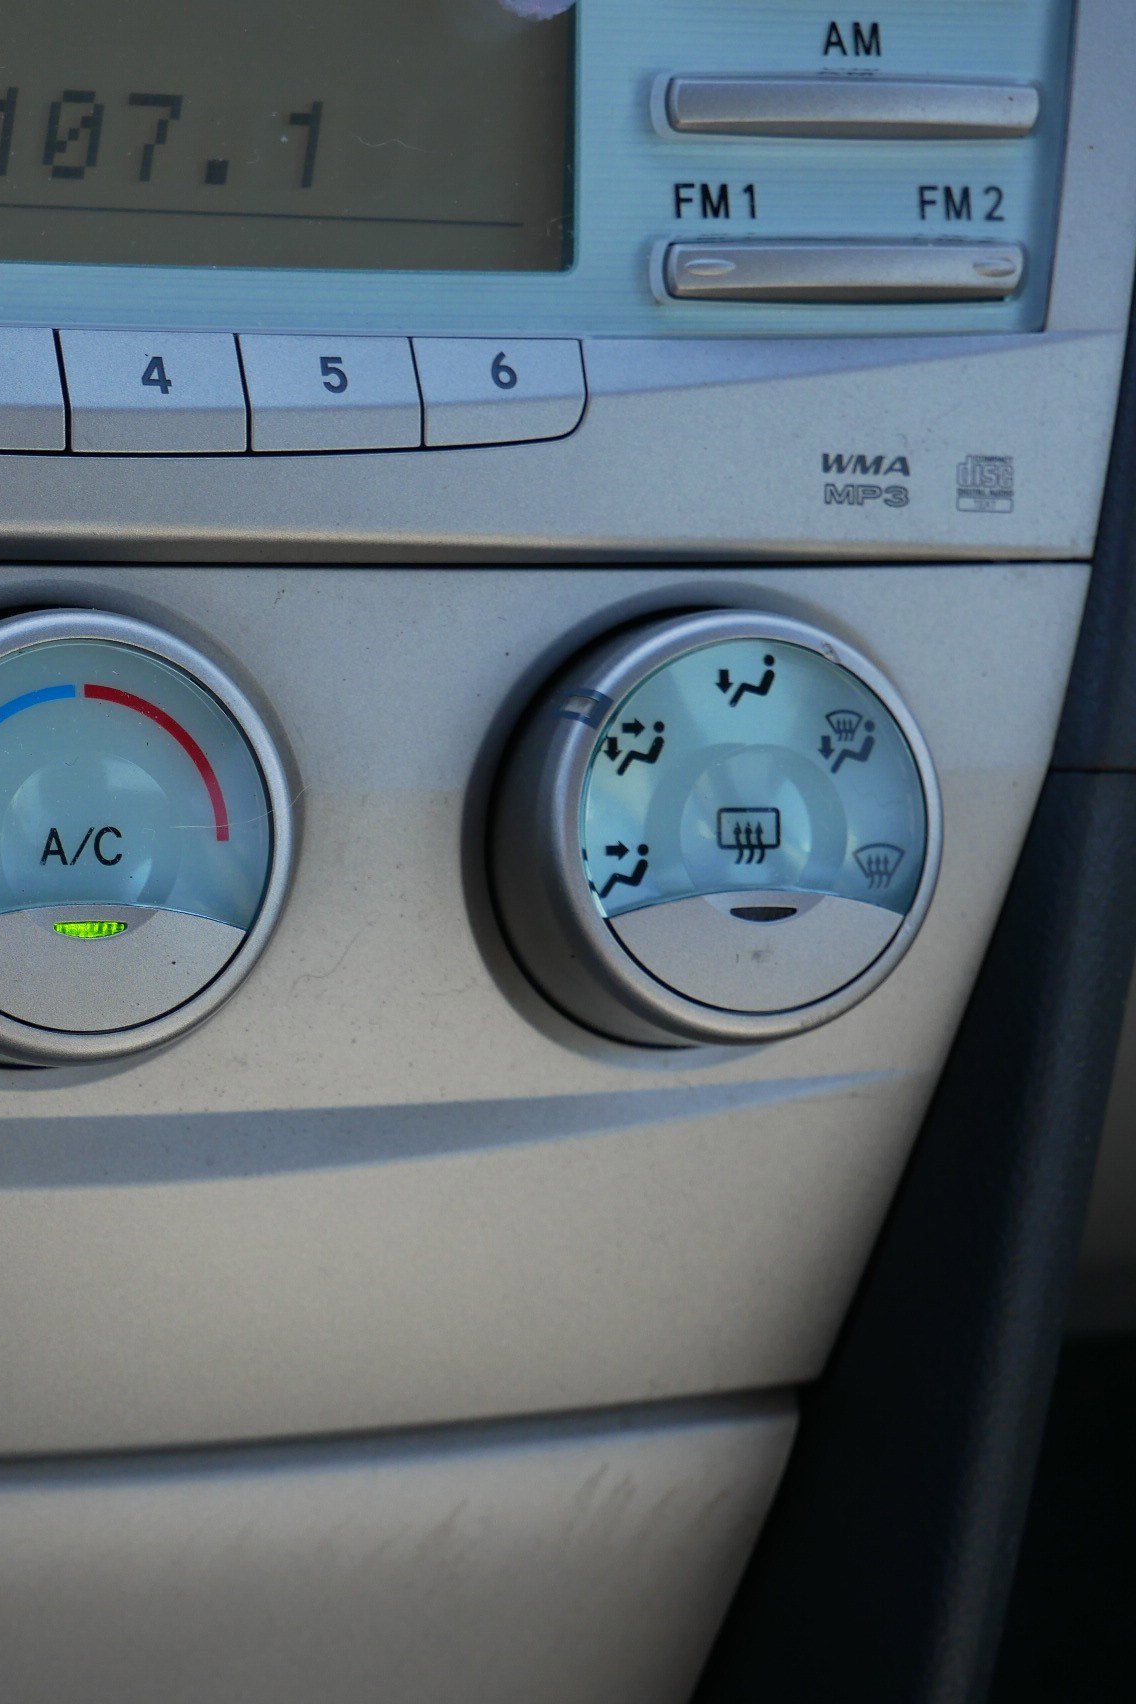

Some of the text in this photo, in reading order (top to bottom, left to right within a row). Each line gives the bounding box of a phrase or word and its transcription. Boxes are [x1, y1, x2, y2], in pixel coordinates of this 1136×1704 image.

[823, 22, 882, 57] AM
[140, 356, 173, 394] 4
[319, 356, 349, 393] 5
[489, 351, 518, 390] 6
[821, 453, 911, 476] WMA
[823, 483, 910, 508] MP3
[39, 825, 124, 867] A/C
